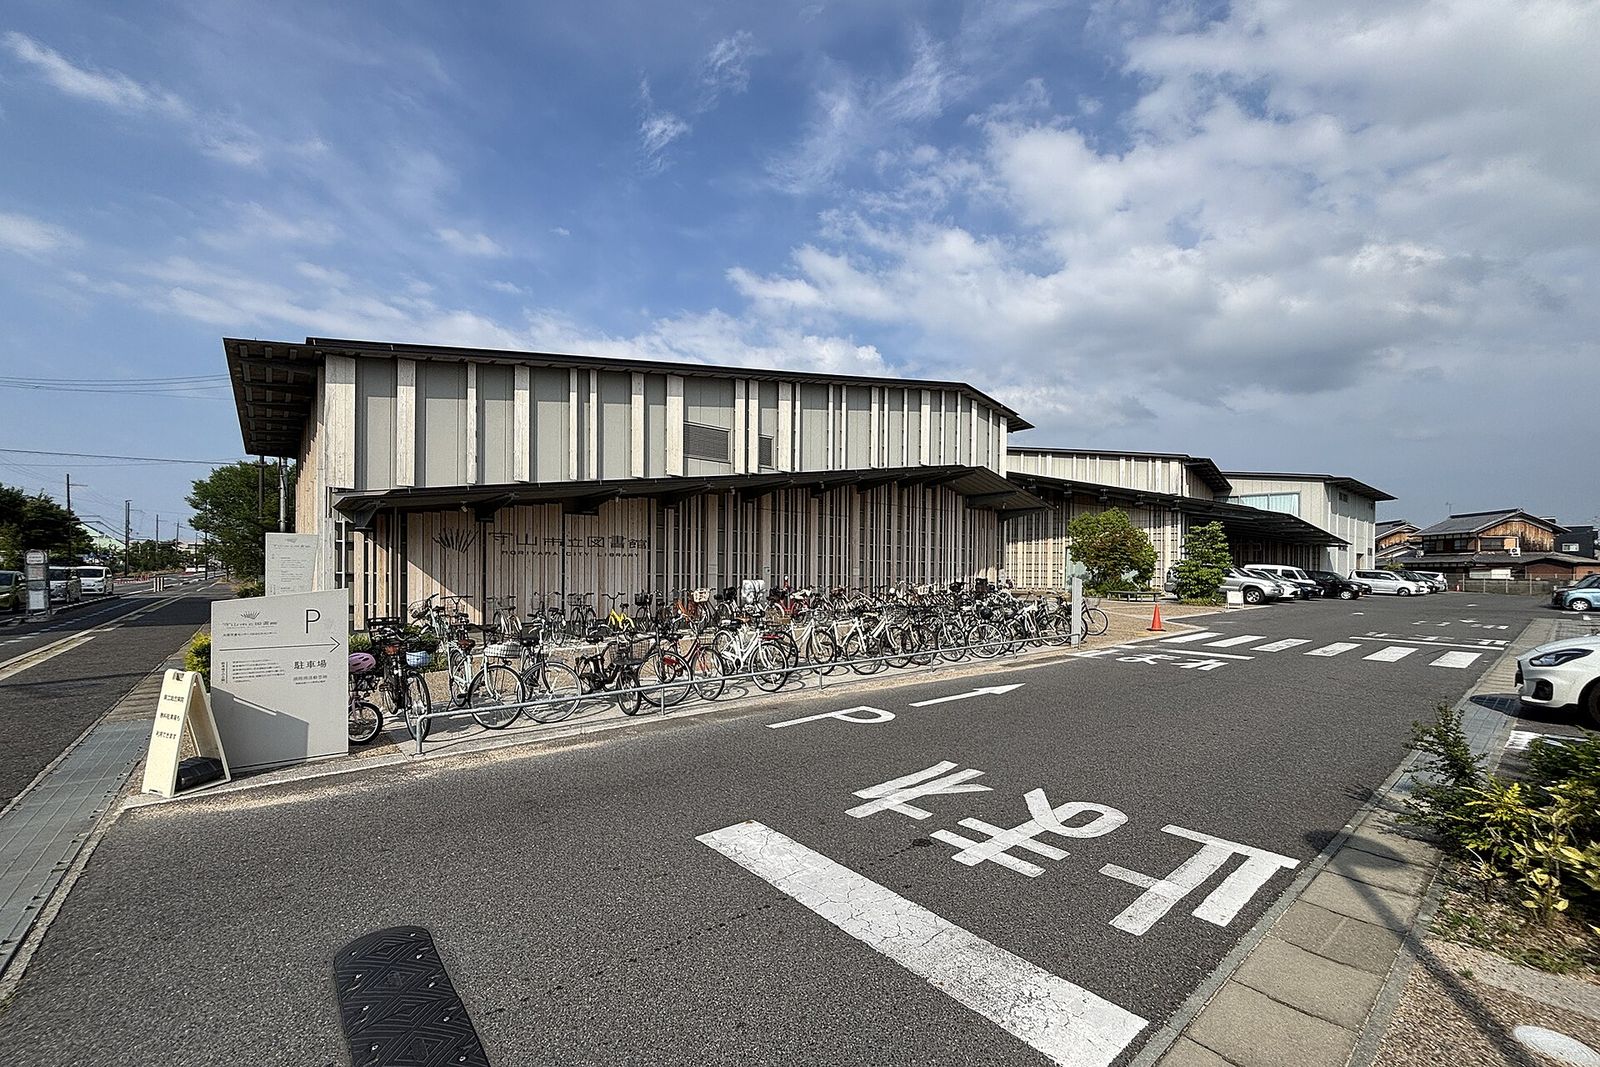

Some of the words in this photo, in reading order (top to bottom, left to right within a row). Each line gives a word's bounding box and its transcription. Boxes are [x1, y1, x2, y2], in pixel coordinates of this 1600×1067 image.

[305, 609, 321, 634] P
[293, 659, 327, 670] 駐車場
